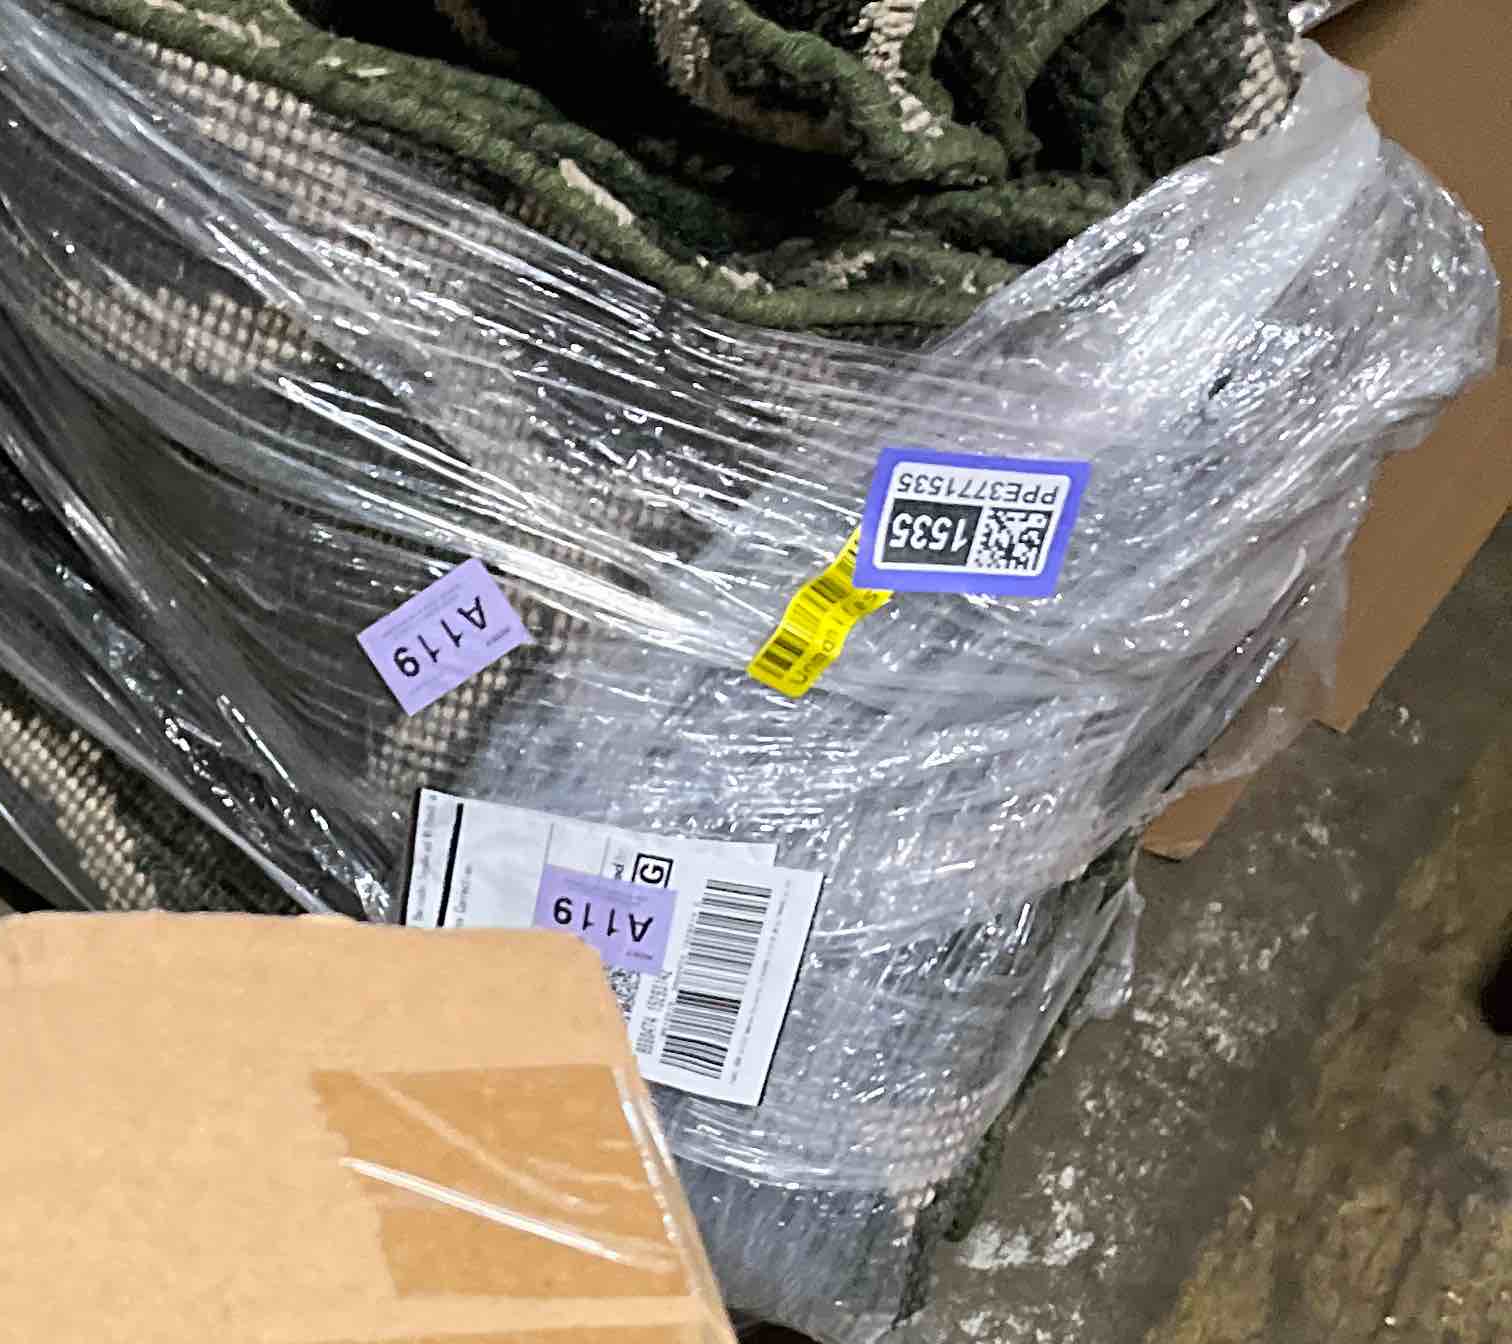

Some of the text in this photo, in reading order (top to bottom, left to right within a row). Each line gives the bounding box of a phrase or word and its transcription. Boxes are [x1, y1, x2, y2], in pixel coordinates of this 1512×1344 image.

[898, 472, 1059, 505] PPE3771535
[888, 511, 969, 552] 1535
[394, 596, 487, 678] A119
[639, 862, 665, 884] G
[553, 896, 654, 943] A119
